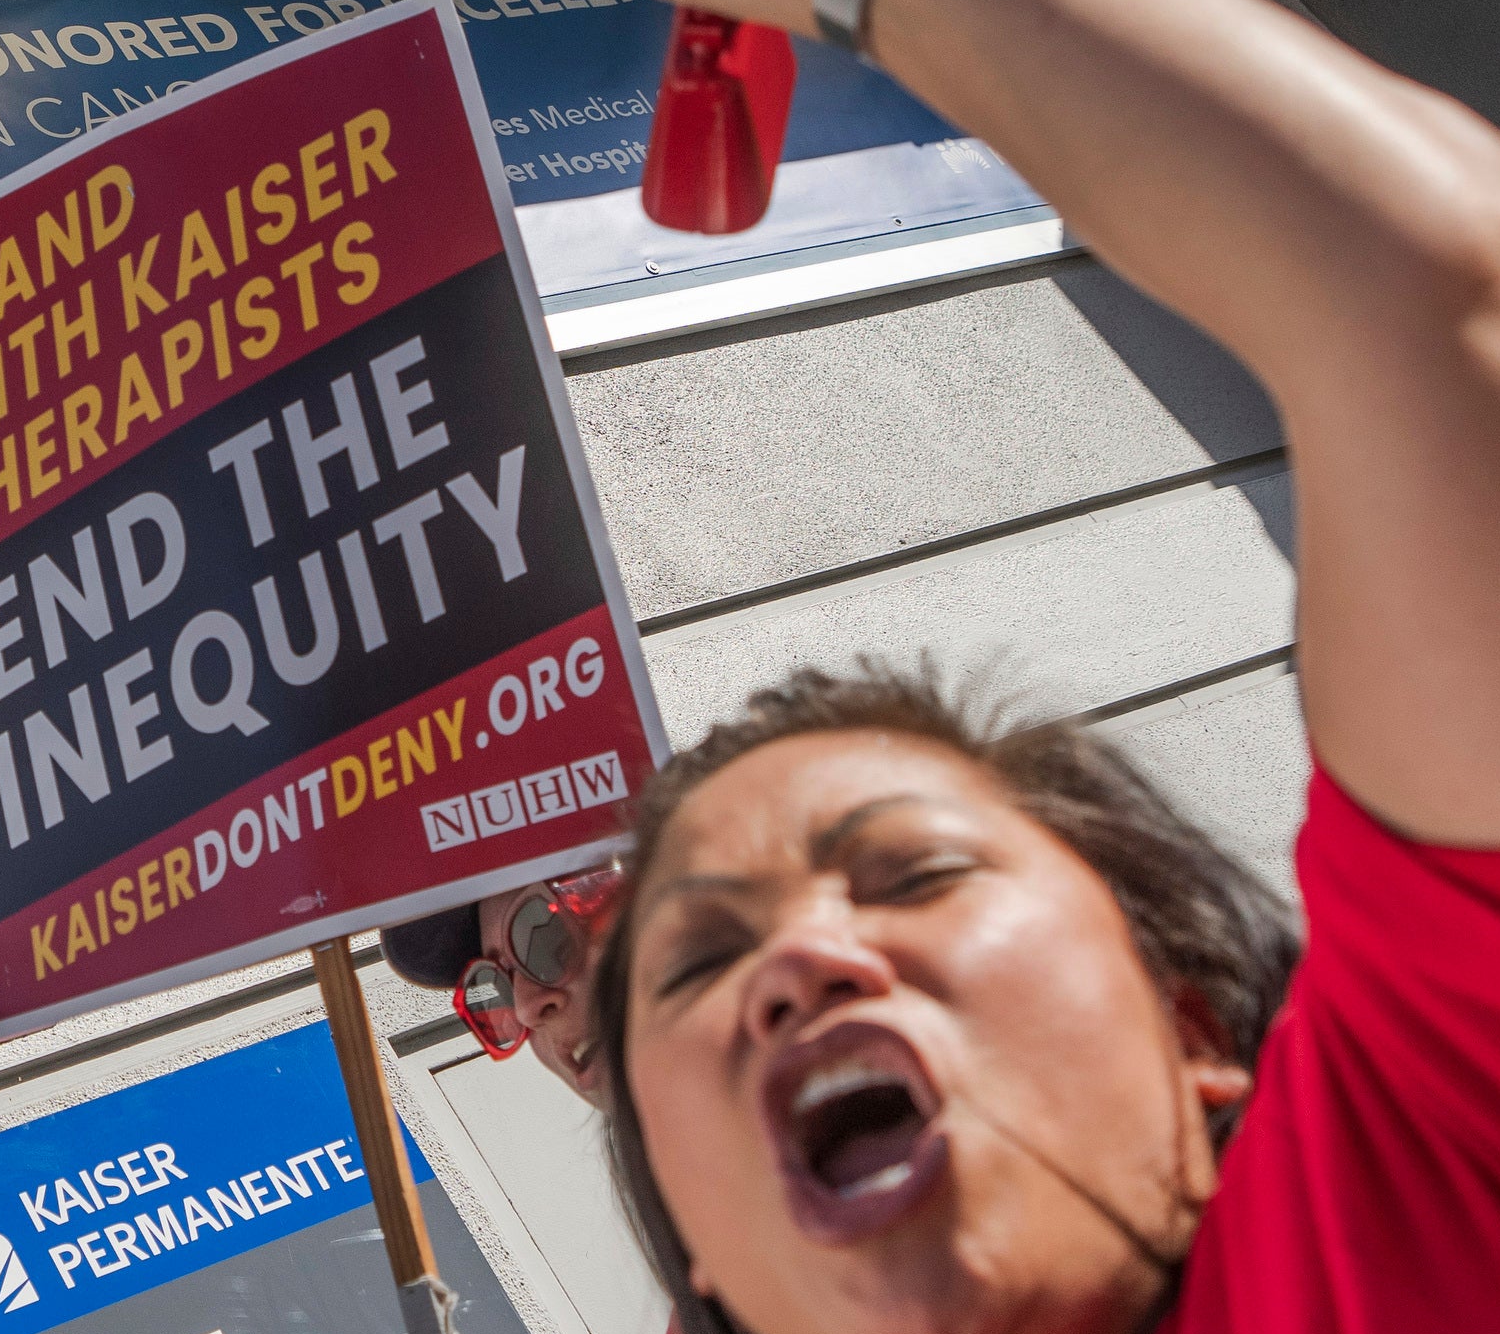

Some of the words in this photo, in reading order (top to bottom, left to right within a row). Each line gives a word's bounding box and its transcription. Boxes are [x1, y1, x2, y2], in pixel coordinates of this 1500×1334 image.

[529, 89, 656, 132] Medical
[538, 139, 651, 178] Hospit
[118, 106, 400, 332] KAISER
[206, 334, 453, 549] THE
[29, 635, 606, 982] KAISERDONTDENY.ORG
[420, 750, 628, 854] NUHW
[18, 1139, 189, 1234] KAISER
[48, 1137, 366, 1291] PERMANENTE
